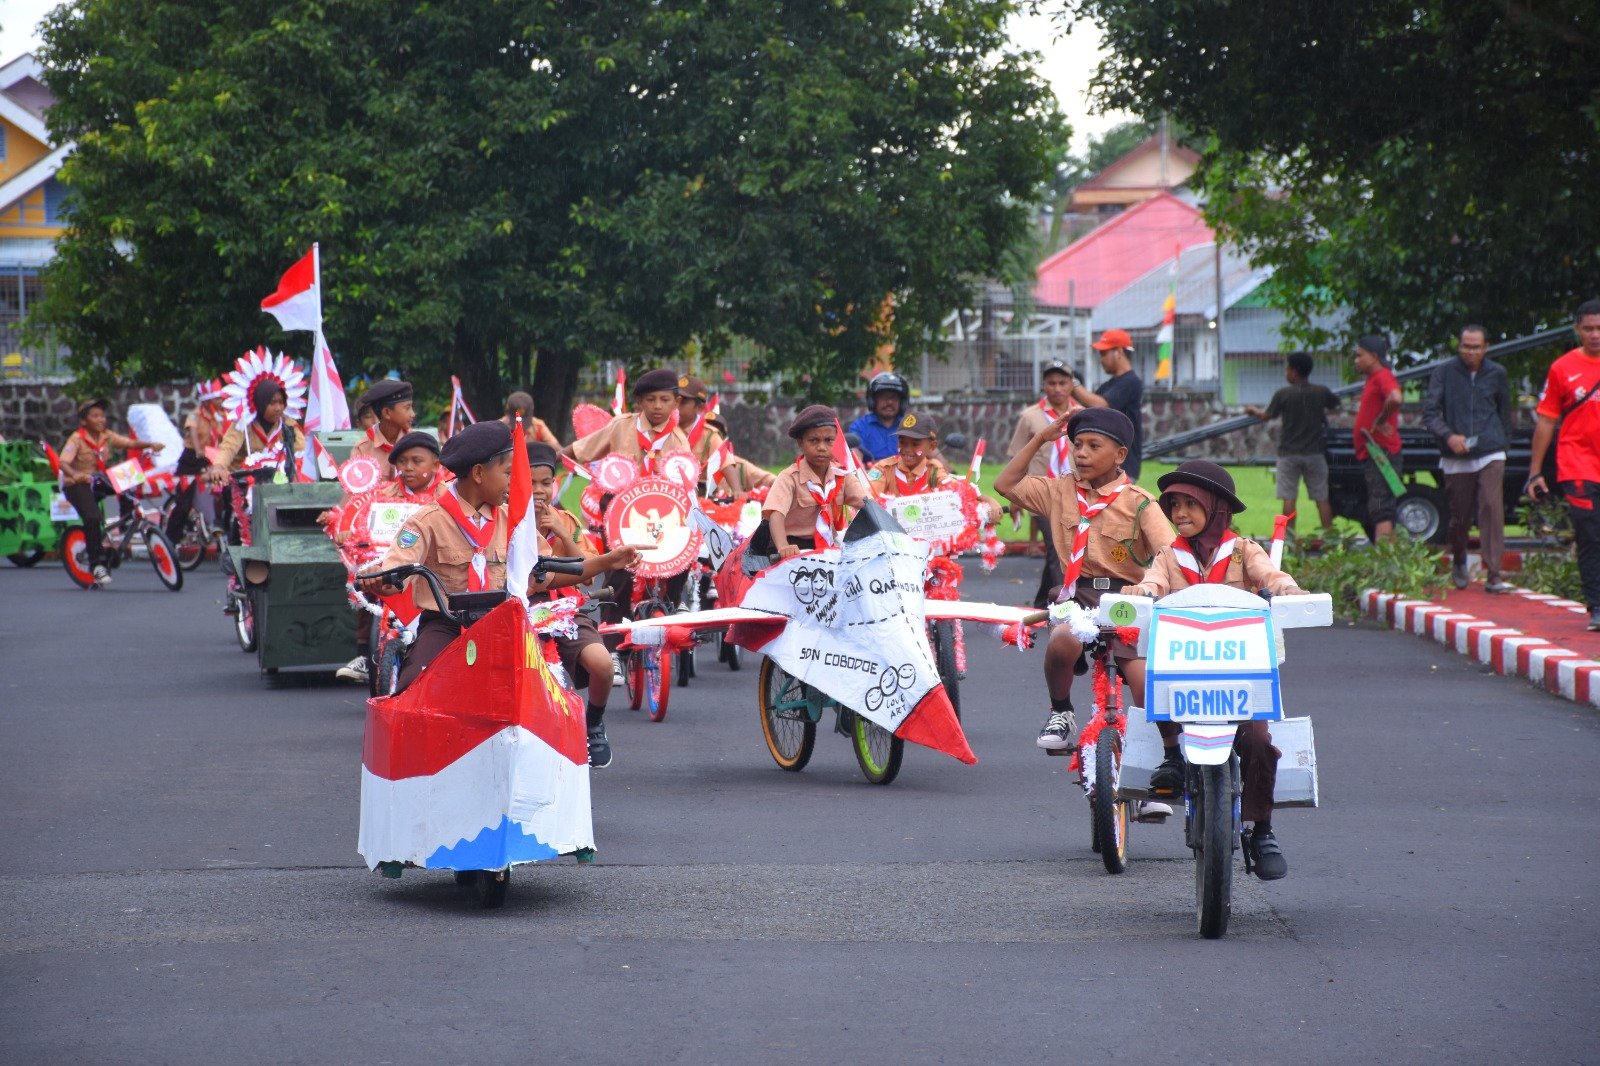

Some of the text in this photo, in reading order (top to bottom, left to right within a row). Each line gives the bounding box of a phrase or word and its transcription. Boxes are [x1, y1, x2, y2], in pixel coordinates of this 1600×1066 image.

[655, 535, 699, 572] INDONESIA
[709, 528, 725, 560] Q
[1115, 609, 1128, 618] 01
[799, 648, 820, 660] SDN
[1169, 640, 1246, 660] POLISI
